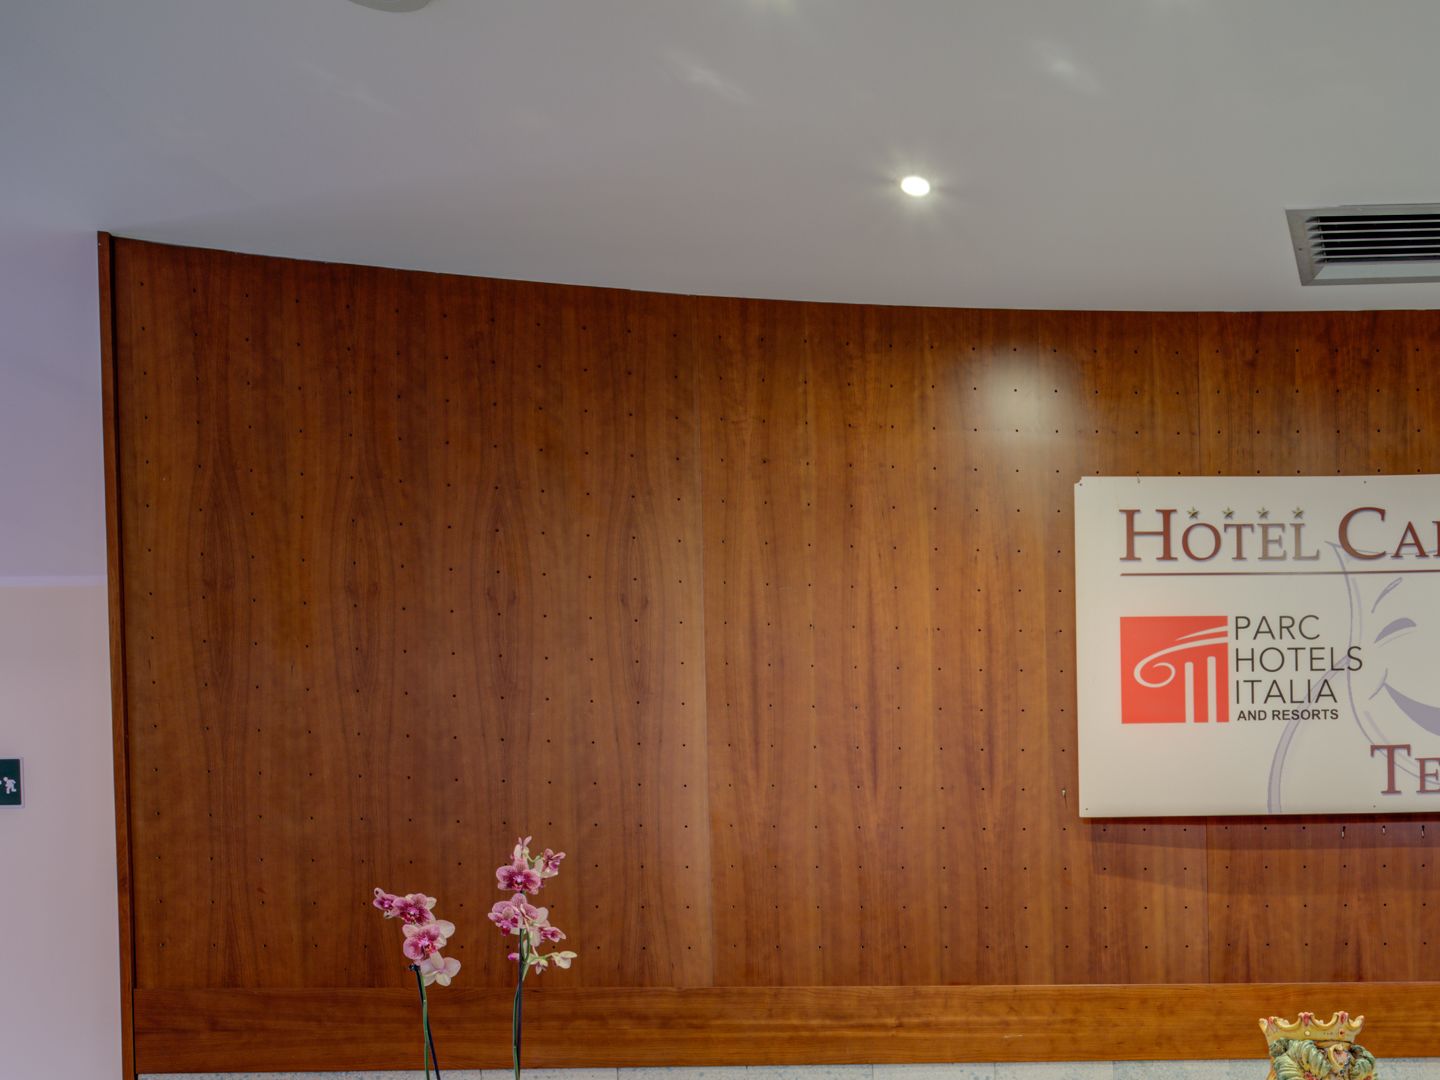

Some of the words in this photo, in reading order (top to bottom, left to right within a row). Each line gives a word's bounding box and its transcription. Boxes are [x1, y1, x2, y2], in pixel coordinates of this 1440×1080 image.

[1119, 508, 1320, 562] HOTEL
[1235, 614, 1320, 640] PARC
[1235, 646, 1363, 673] HOTELS
[1236, 679, 1338, 704] ITALIA
[1237, 710, 1267, 721] AND
[1271, 708, 1339, 721] RESORTS
